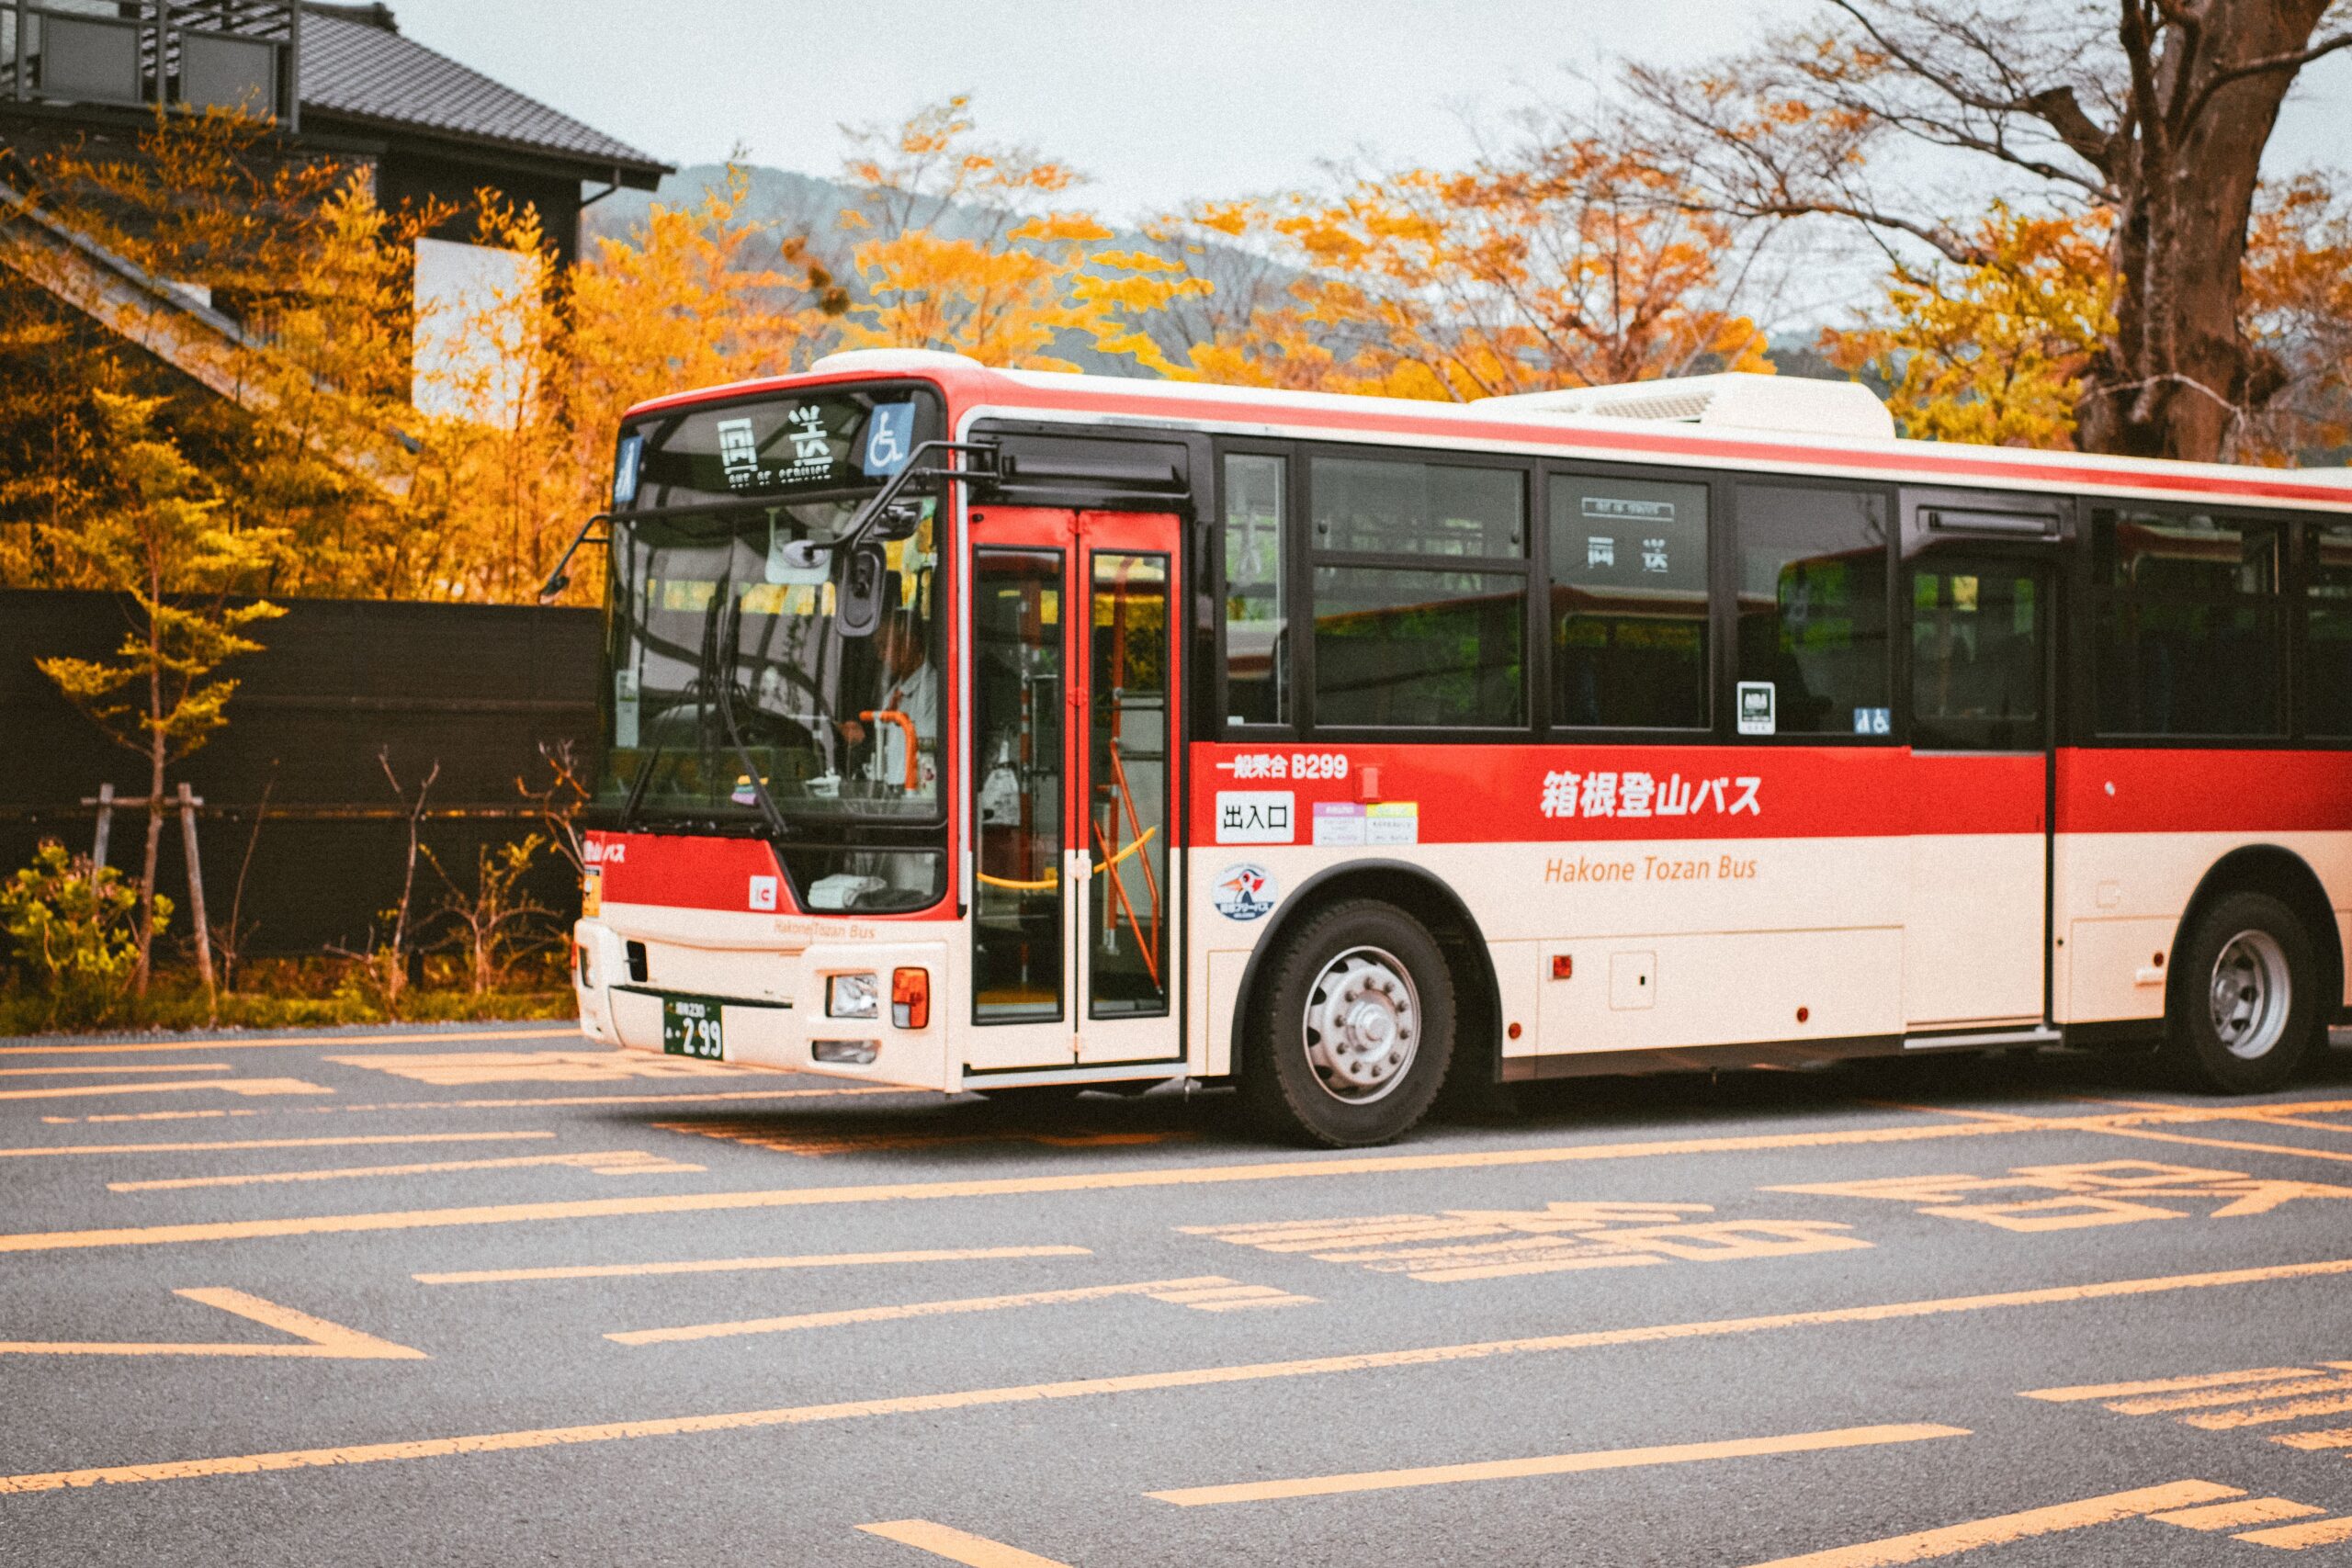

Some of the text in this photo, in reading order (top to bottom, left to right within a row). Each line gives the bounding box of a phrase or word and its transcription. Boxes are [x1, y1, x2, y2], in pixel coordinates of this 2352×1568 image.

[1216, 753, 1348, 779] 一般乗合 B299
[1540, 770, 1761, 818] 箱根登山バス
[1223, 805, 1287, 829] 出入口
[1544, 854, 1759, 883] Hakone Tozan Bus
[850, 924, 876, 939] Bus
